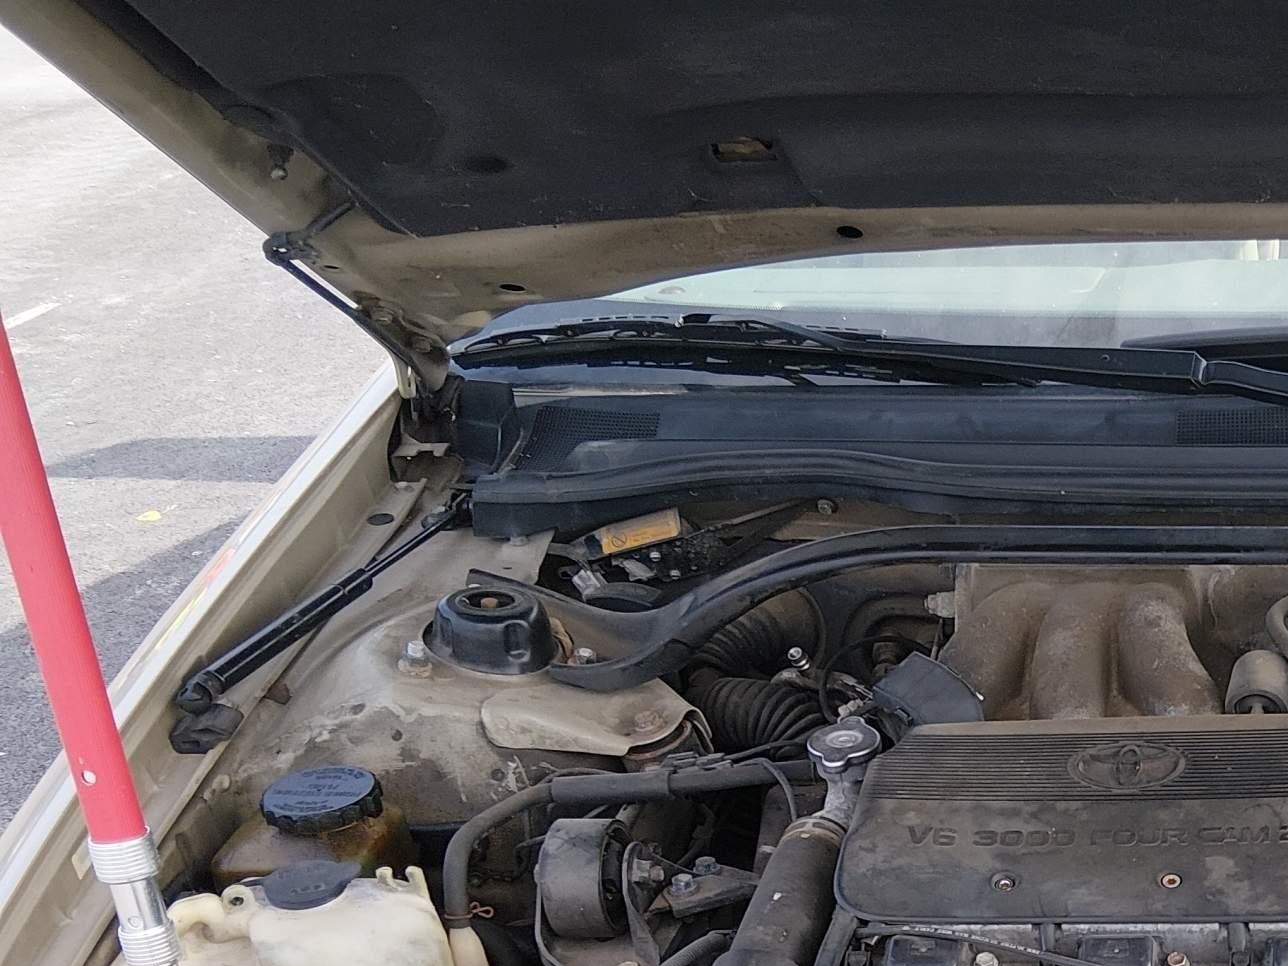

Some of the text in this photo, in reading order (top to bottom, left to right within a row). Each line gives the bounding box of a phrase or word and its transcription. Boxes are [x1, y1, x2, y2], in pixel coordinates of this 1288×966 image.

[907, 825, 957, 847] V6
[972, 829, 1076, 847] 3000
[1090, 827, 1189, 846] FOUR
[1199, 824, 1272, 845] CAM
